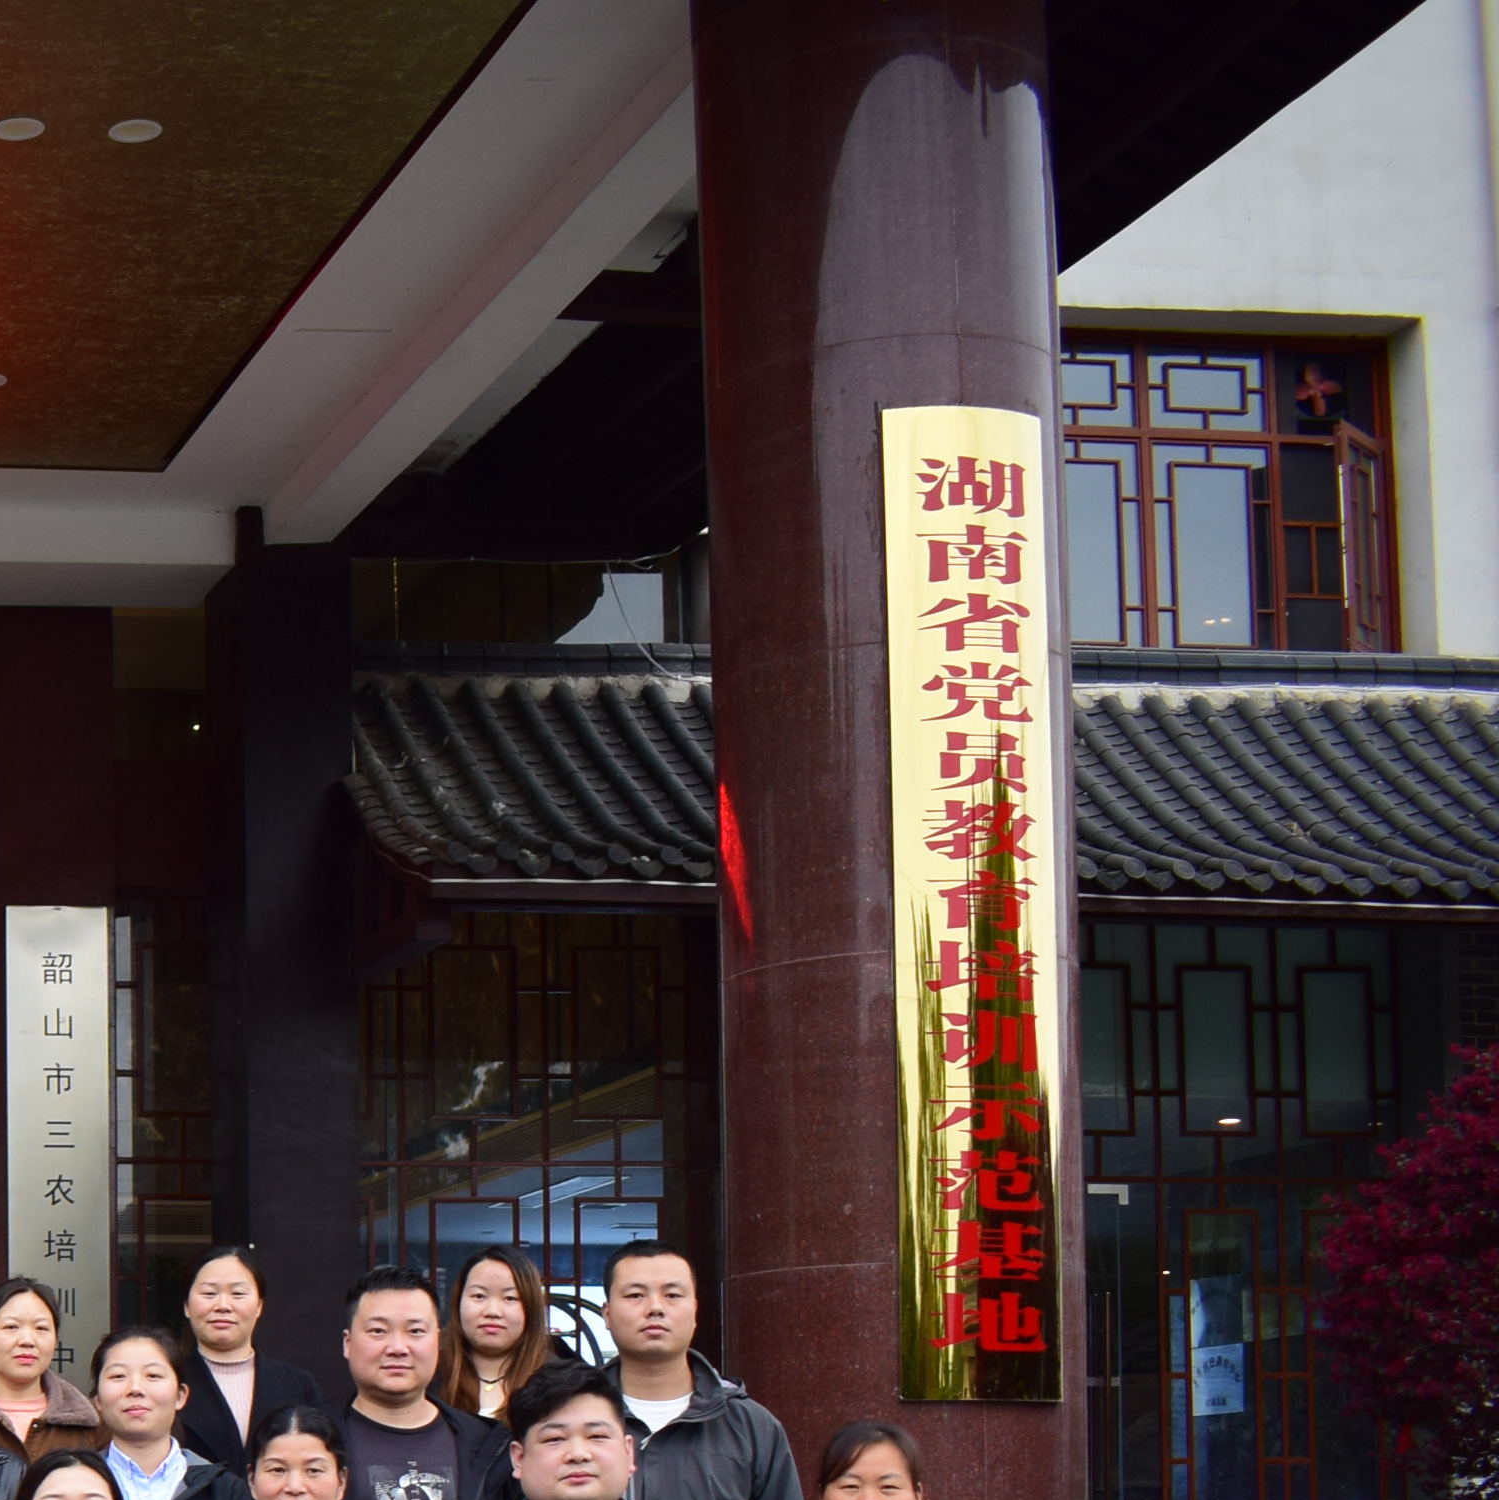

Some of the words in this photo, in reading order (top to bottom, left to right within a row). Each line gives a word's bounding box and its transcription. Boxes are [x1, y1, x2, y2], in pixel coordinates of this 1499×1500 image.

[914, 456, 1048, 1354] 湖南省党员教育培训示范基地
